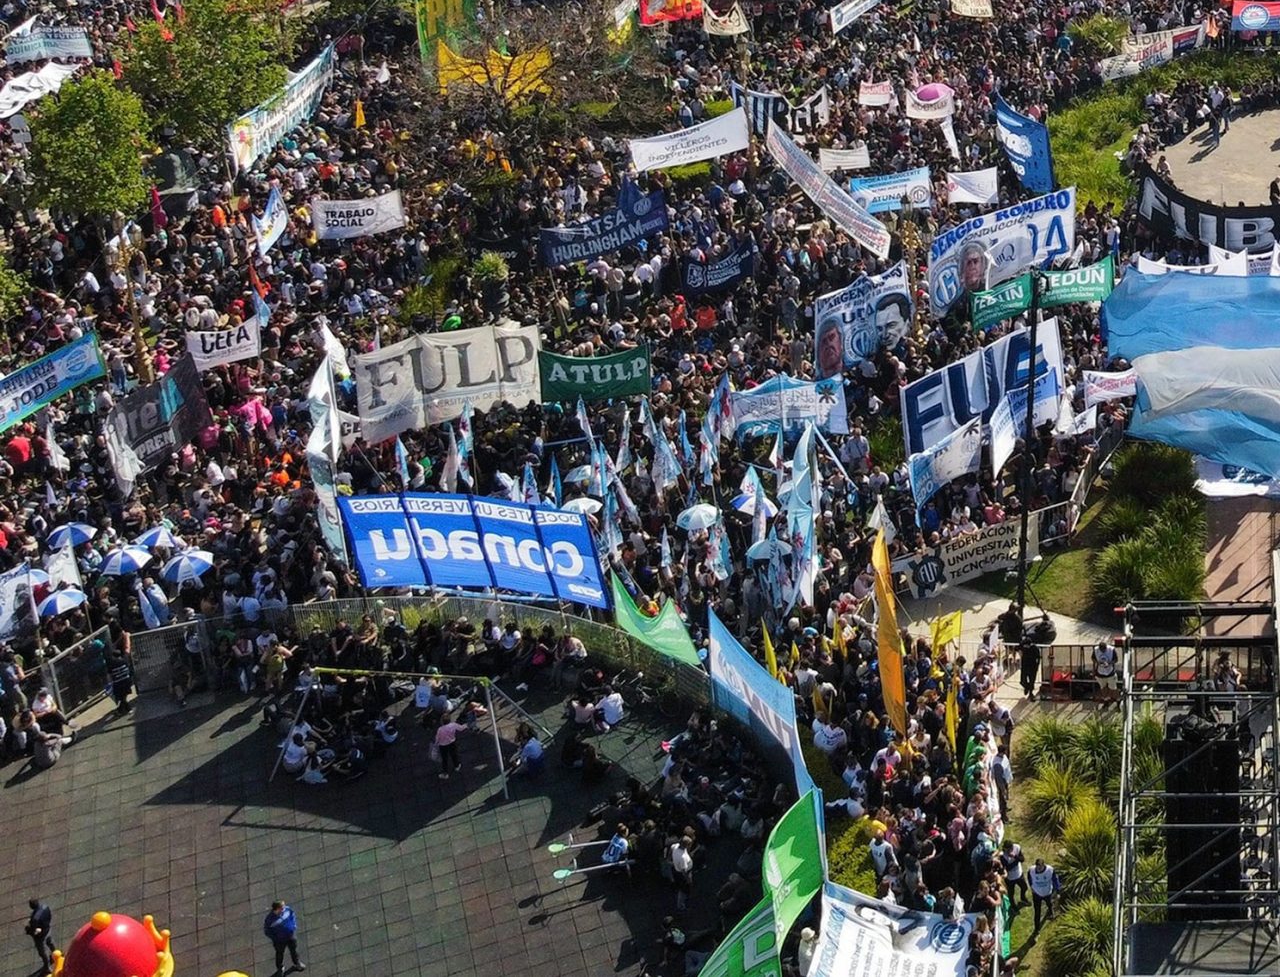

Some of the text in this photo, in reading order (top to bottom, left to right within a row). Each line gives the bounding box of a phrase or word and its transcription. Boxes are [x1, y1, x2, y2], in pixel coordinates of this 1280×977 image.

[648, 138, 728, 162] INDEPENDIENTES
[665, 135, 711, 151] VILLEROS
[325, 208, 374, 219] TRABAJO
[325, 219, 364, 228] SOCIAL
[583, 210, 627, 239] ATSA
[930, 189, 1070, 262] SERGIO ROMERO
[552, 219, 642, 263] HURLINGHAM
[200, 325, 251, 354] CEFA
[364, 334, 533, 411] FULP
[549, 356, 647, 384] ATULP
[10, 375, 58, 413] JODE
[945, 525, 1015, 553] FEDERACION
[949, 551, 1018, 579] TECNOLOGIC
